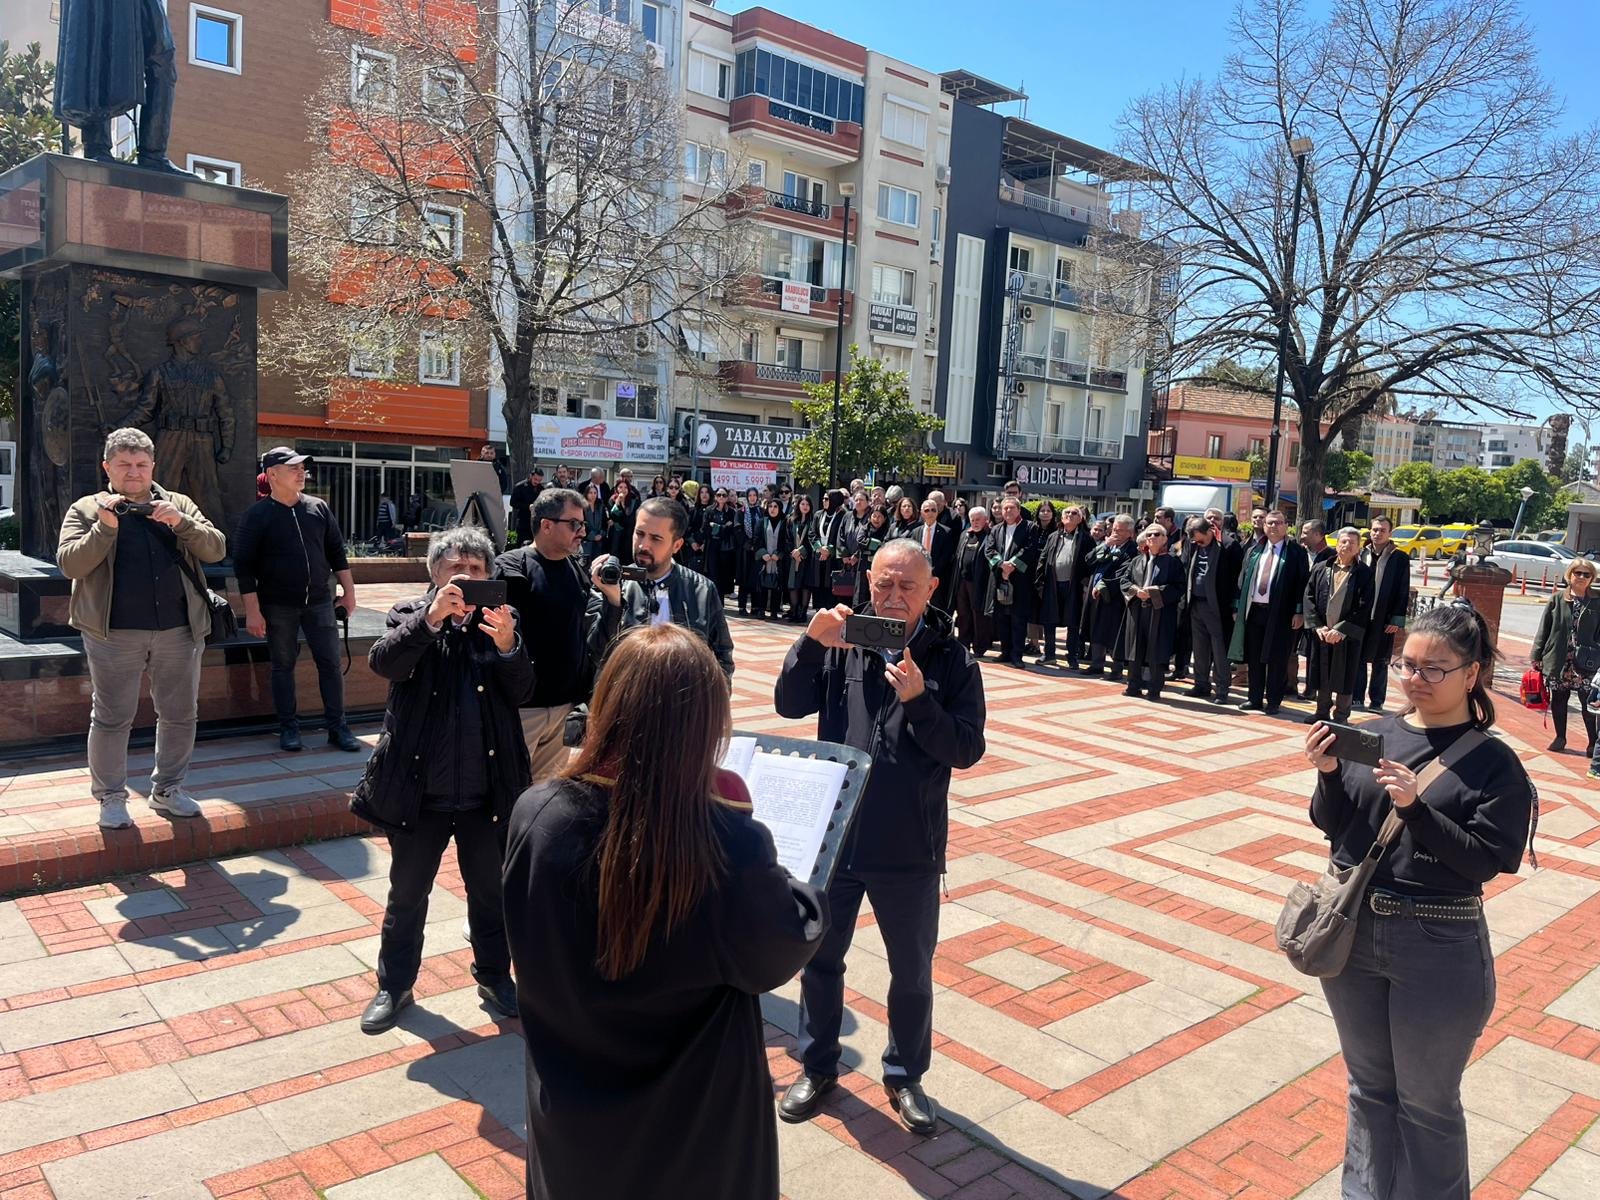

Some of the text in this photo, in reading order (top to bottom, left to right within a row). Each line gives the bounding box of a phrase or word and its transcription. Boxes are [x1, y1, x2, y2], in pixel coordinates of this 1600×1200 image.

[872, 305, 893, 316] AVUKAT
[896, 310, 916, 321] AVUKAT
[725, 427, 772, 444] TABAK
[533, 447, 557, 455] EARENA
[731, 444, 795, 460] AYAKKAB
[732, 475, 741, 485] TL
